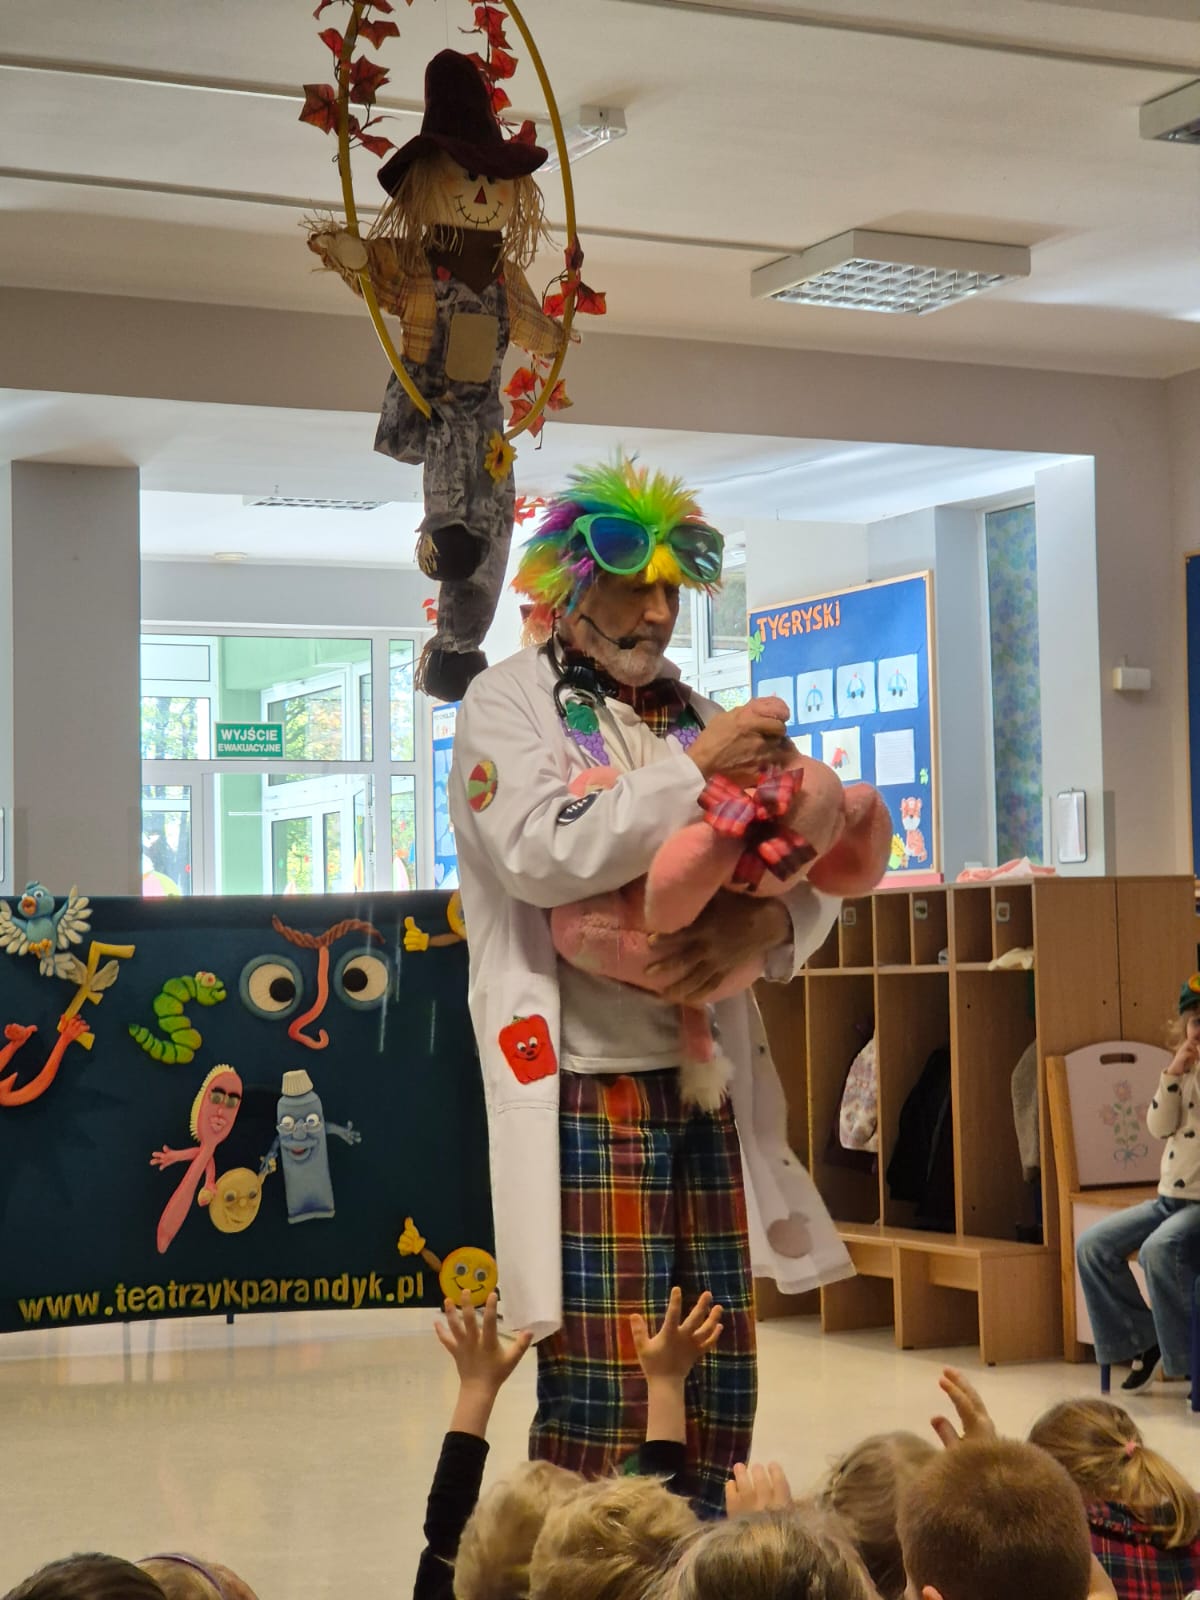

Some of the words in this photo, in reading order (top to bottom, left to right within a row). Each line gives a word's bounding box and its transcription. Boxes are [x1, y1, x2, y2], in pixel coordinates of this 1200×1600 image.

[220, 726, 279, 741] WYJŚCIE
[217, 743, 282, 753] EWAKUACYJNE
[18, 1271, 424, 1323] www.teatrzykparandyk.pl
